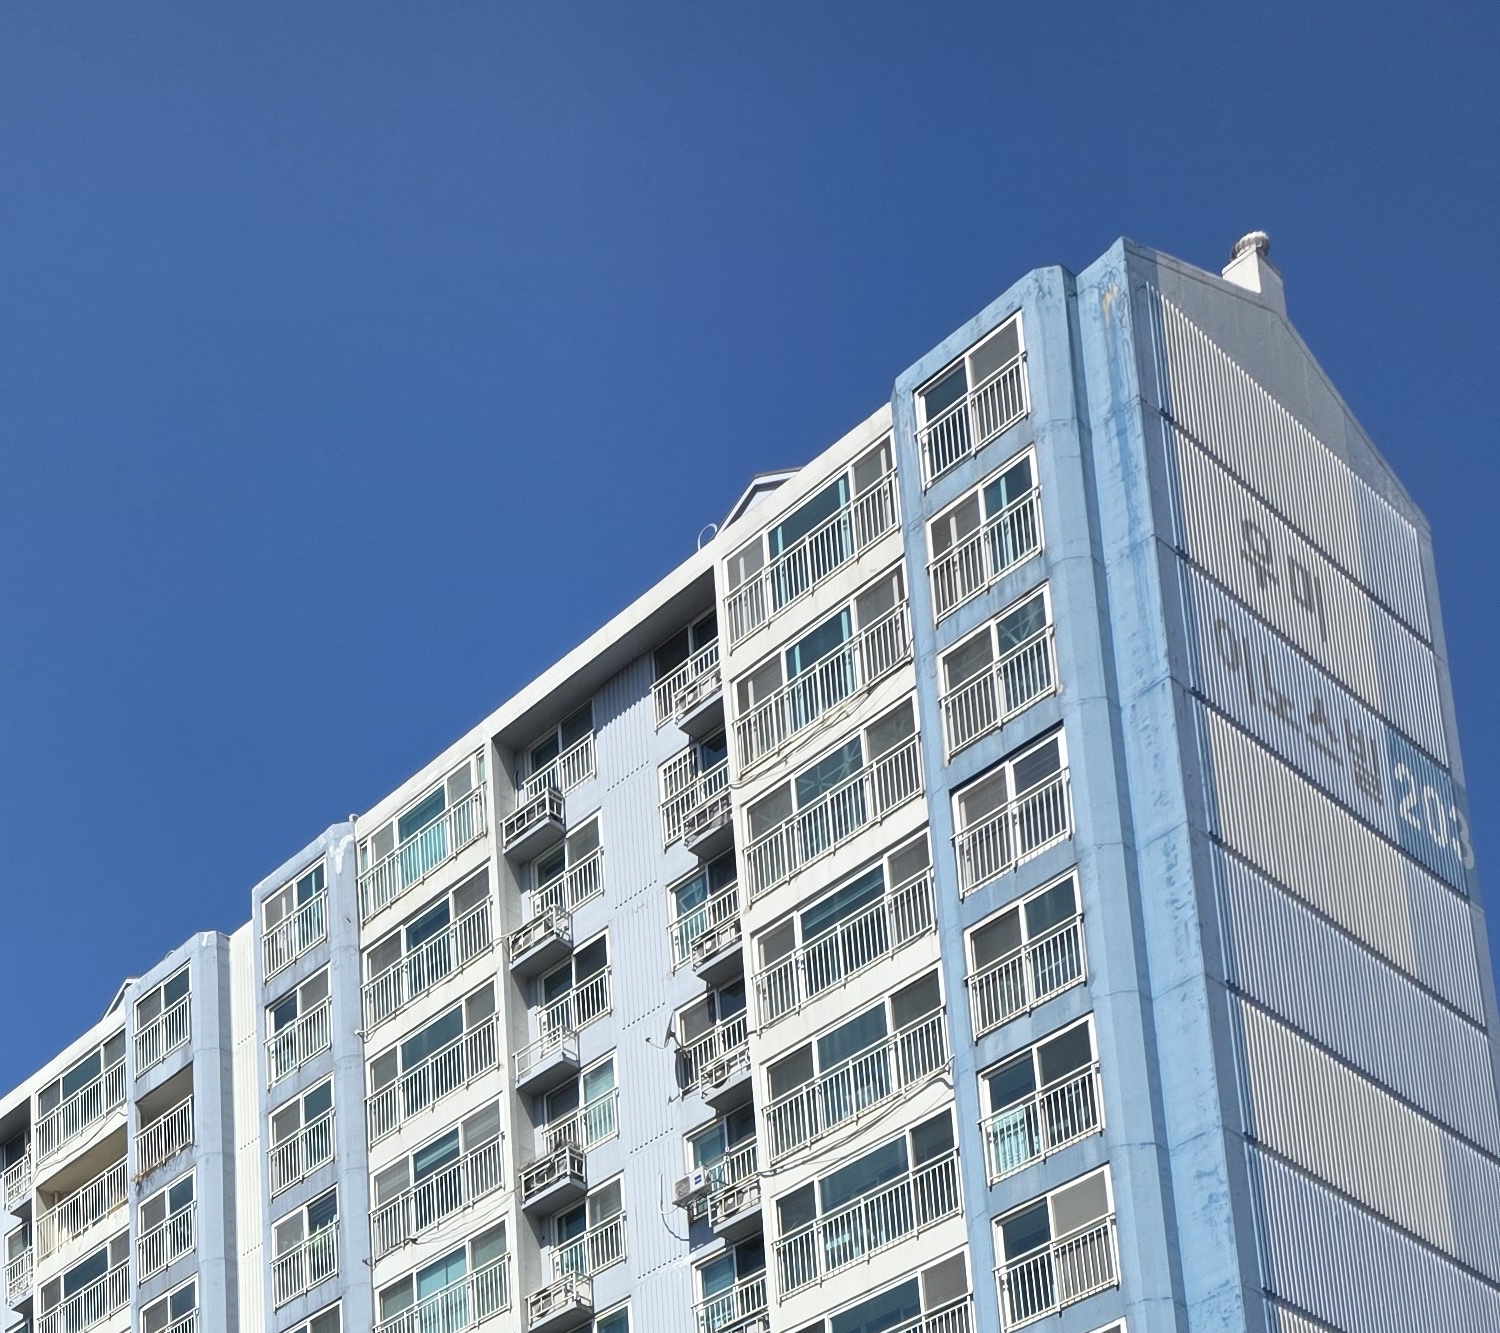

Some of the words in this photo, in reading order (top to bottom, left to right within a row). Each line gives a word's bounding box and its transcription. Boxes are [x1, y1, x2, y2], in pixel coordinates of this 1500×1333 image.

[1243, 518, 1328, 643] 우미
[1213, 618, 1384, 806] 이노스빌
[1395, 761, 1475, 870] 203
